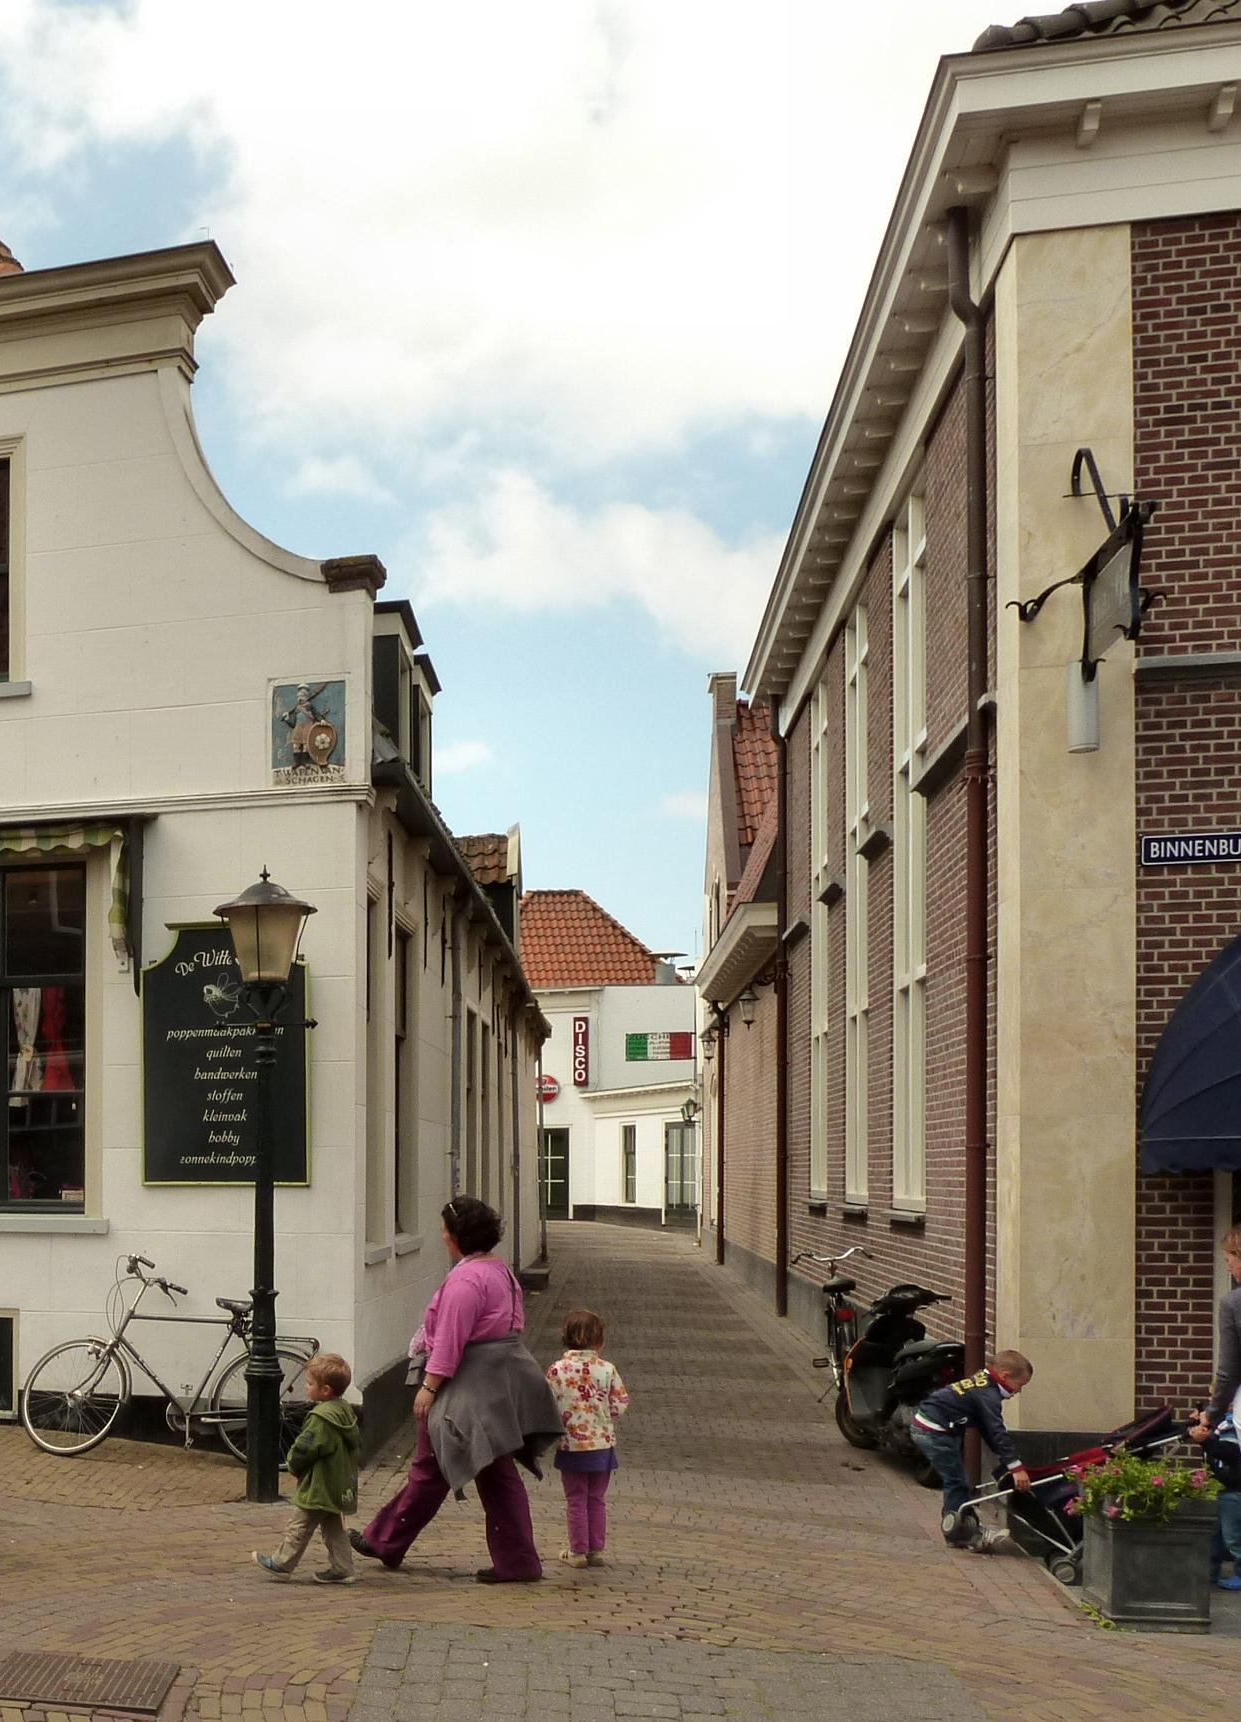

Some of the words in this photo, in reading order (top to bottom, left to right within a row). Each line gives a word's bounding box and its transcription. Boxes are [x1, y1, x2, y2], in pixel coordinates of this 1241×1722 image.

[1149, 838, 1241, 858] BINNENBU
[174, 961, 195, 976] De
[193, 948, 233, 967] Witte
[206, 1045, 242, 1061] quilten
[575, 1021, 586, 1082] DISCO
[206, 1088, 244, 1104] stoffen
[202, 1108, 248, 1122] kleinvak
